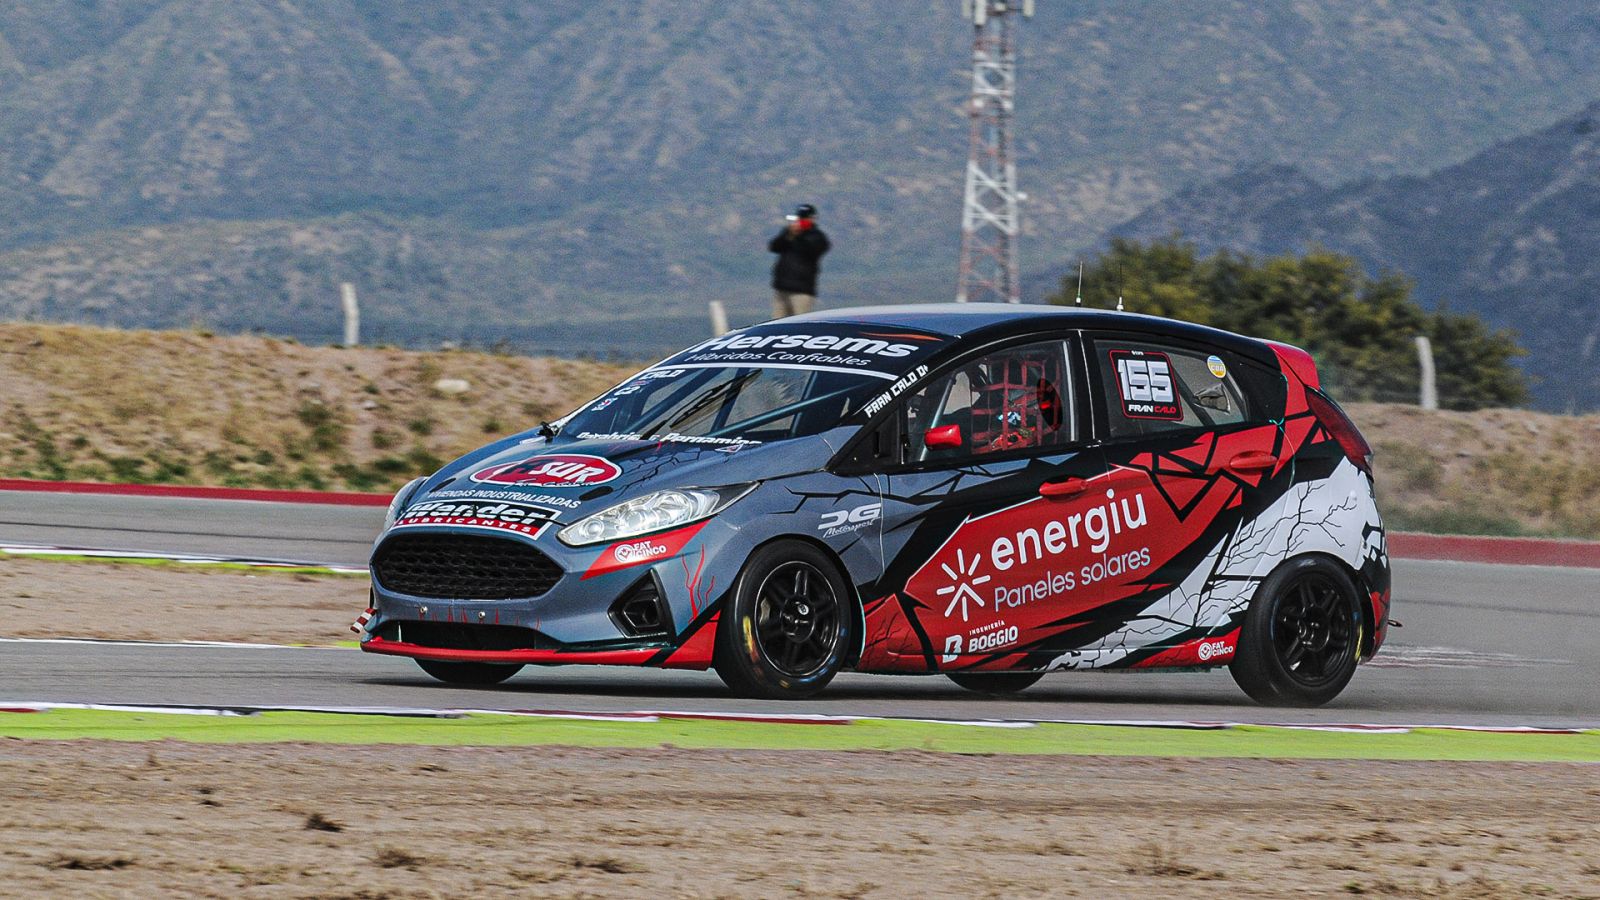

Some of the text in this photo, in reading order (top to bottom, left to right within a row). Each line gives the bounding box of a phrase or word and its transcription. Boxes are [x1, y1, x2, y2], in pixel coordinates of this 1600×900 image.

[688, 334, 919, 357] Hersems
[766, 351, 871, 366] Confiables
[1118, 359, 1174, 403] 155
[864, 391, 892, 418] FRAN
[889, 371, 918, 397] CALO
[1128, 404, 1177, 414] FRAN CALO
[472, 489, 582, 509] INDUSTRIALIZADAS
[398, 516, 532, 533] LUBRICANTES
[823, 518, 876, 538] Motorsport
[991, 488, 1148, 571] energiu
[633, 541, 651, 550] FAT
[635, 545, 667, 557] CINCO
[994, 547, 1151, 612] Paneles solares
[968, 625, 1019, 653] BOGGIO
[1211, 641, 1225, 650] FAT
[1212, 645, 1234, 657] CINCO
